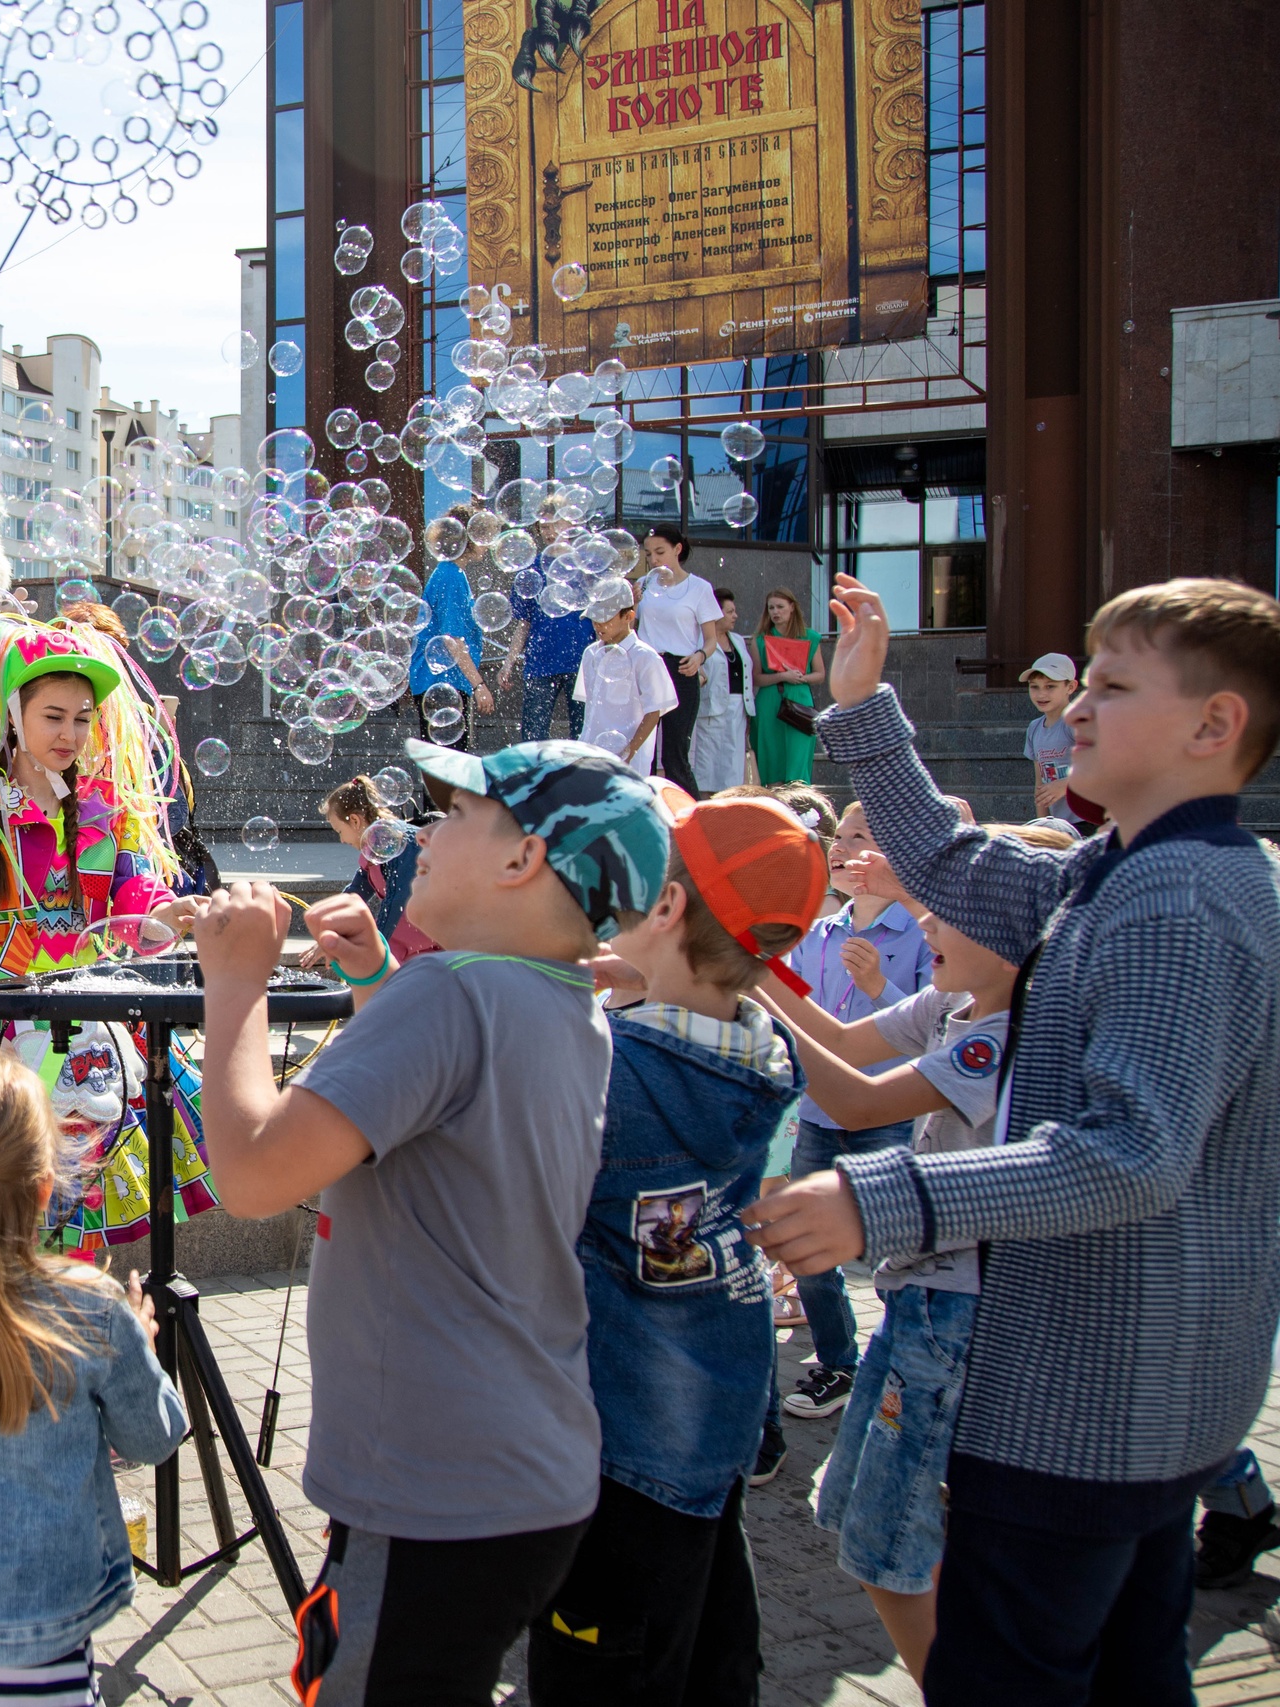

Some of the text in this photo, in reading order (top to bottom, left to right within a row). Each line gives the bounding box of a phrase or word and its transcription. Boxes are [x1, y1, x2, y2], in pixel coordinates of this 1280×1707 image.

[656, 0, 707, 33] НА
[585, 22, 784, 91] ЗМЕИНОМ
[607, 73, 764, 133] БОЛОТЕ
[718, 135, 782, 160] СКАЗКА
[594, 195, 656, 213] Режиссёр
[668, 189, 698, 203] Олег
[701, 178, 781, 198] Загумённов
[587, 216, 651, 234] Художник
[662, 208, 700, 224] Ольга
[703, 196, 789, 218] Колесникова
[592, 232, 661, 252] Хореограф
[673, 226, 727, 242] Алексей
[730, 217, 785, 235] Кривега
[634, 256, 649, 266] по
[653, 251, 689, 265] свету
[701, 240, 753, 257] Максим
[757, 232, 814, 249] Шлыков
[739, 319, 770, 330] РЕНЕТ
[771, 315, 794, 326] КОМ
[814, 307, 857, 319] ПРАКТИК
[629, 327, 699, 342] ПУШКИНСКАЯ
[637, 336, 672, 346] КАРТА
